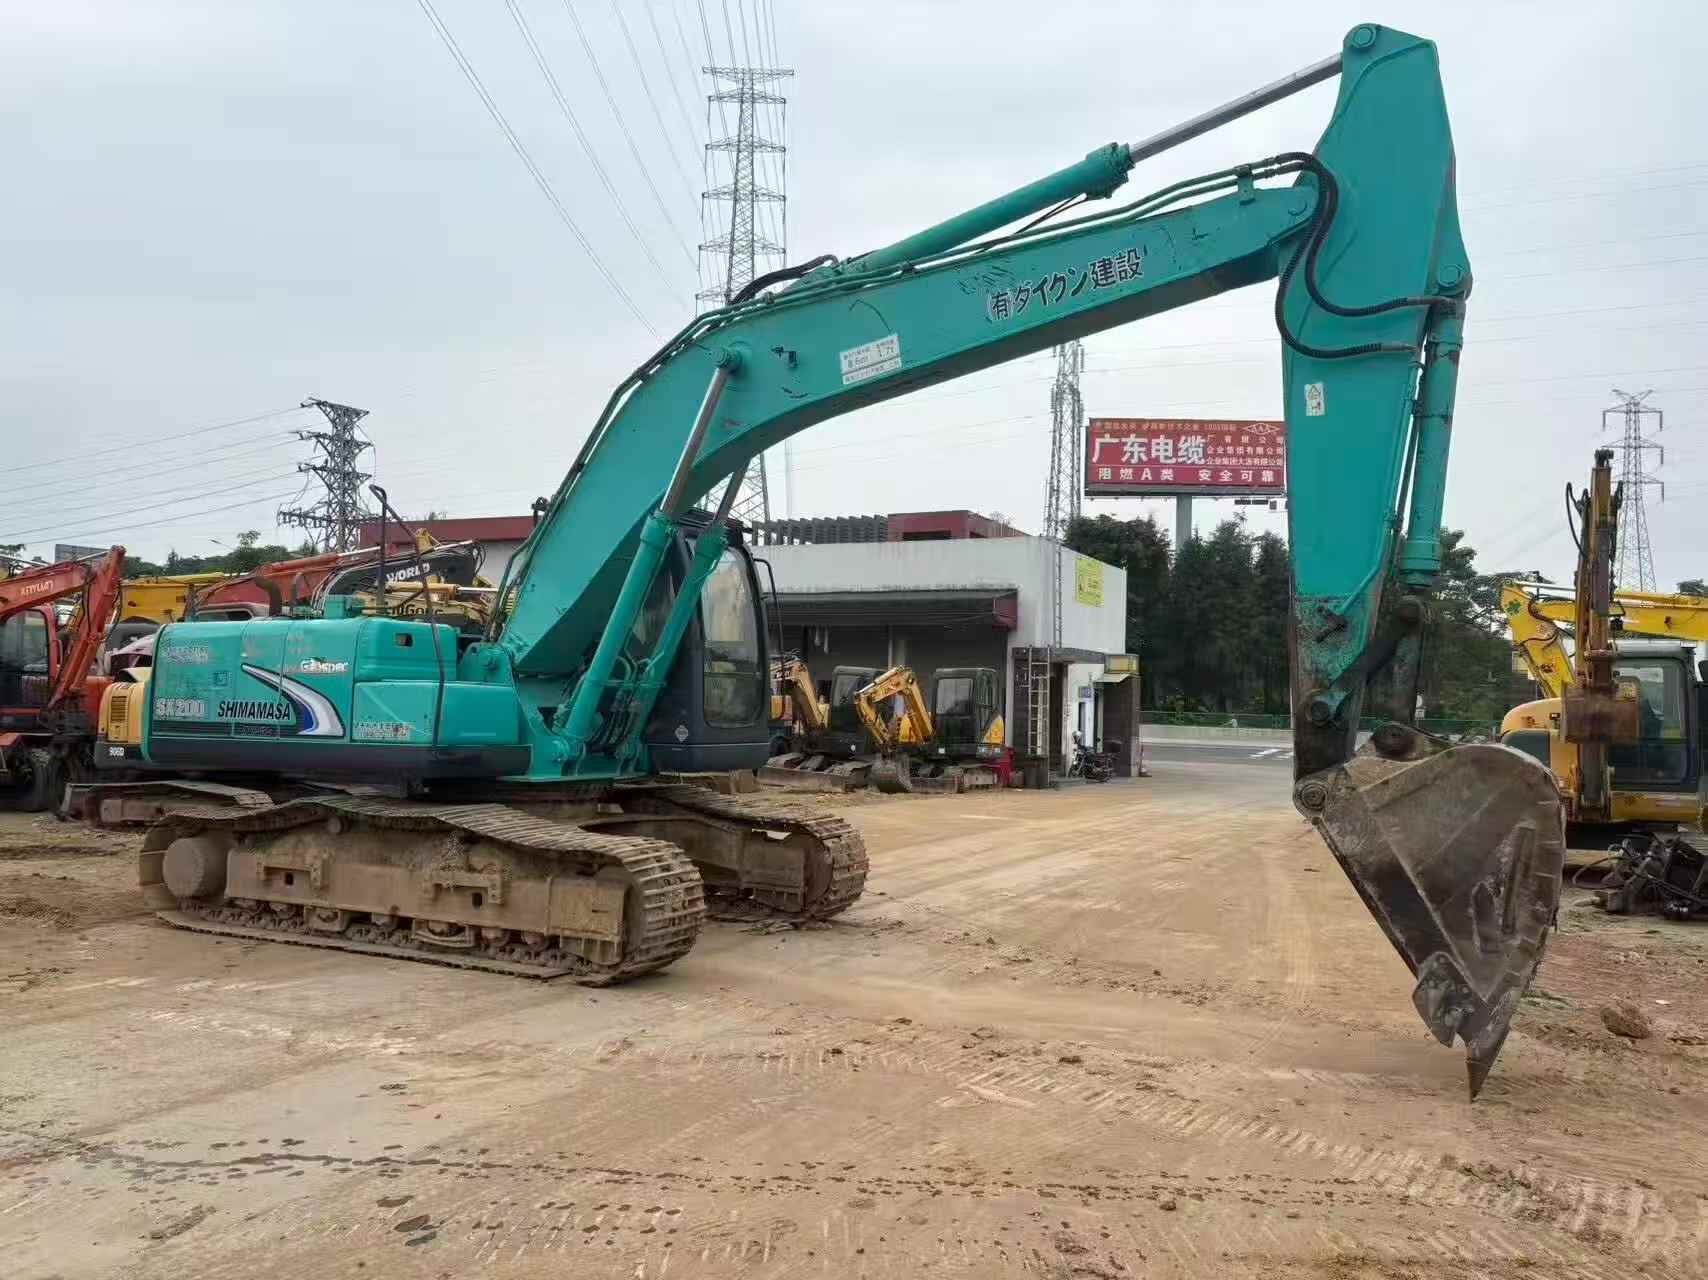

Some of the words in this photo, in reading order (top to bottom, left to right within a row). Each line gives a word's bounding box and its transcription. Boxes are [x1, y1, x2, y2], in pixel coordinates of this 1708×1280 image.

[1092, 433, 1206, 465] 广东电缆
[1199, 469, 1275, 482] 安全可靠
[218, 700, 291, 721] SHIMAMASA
